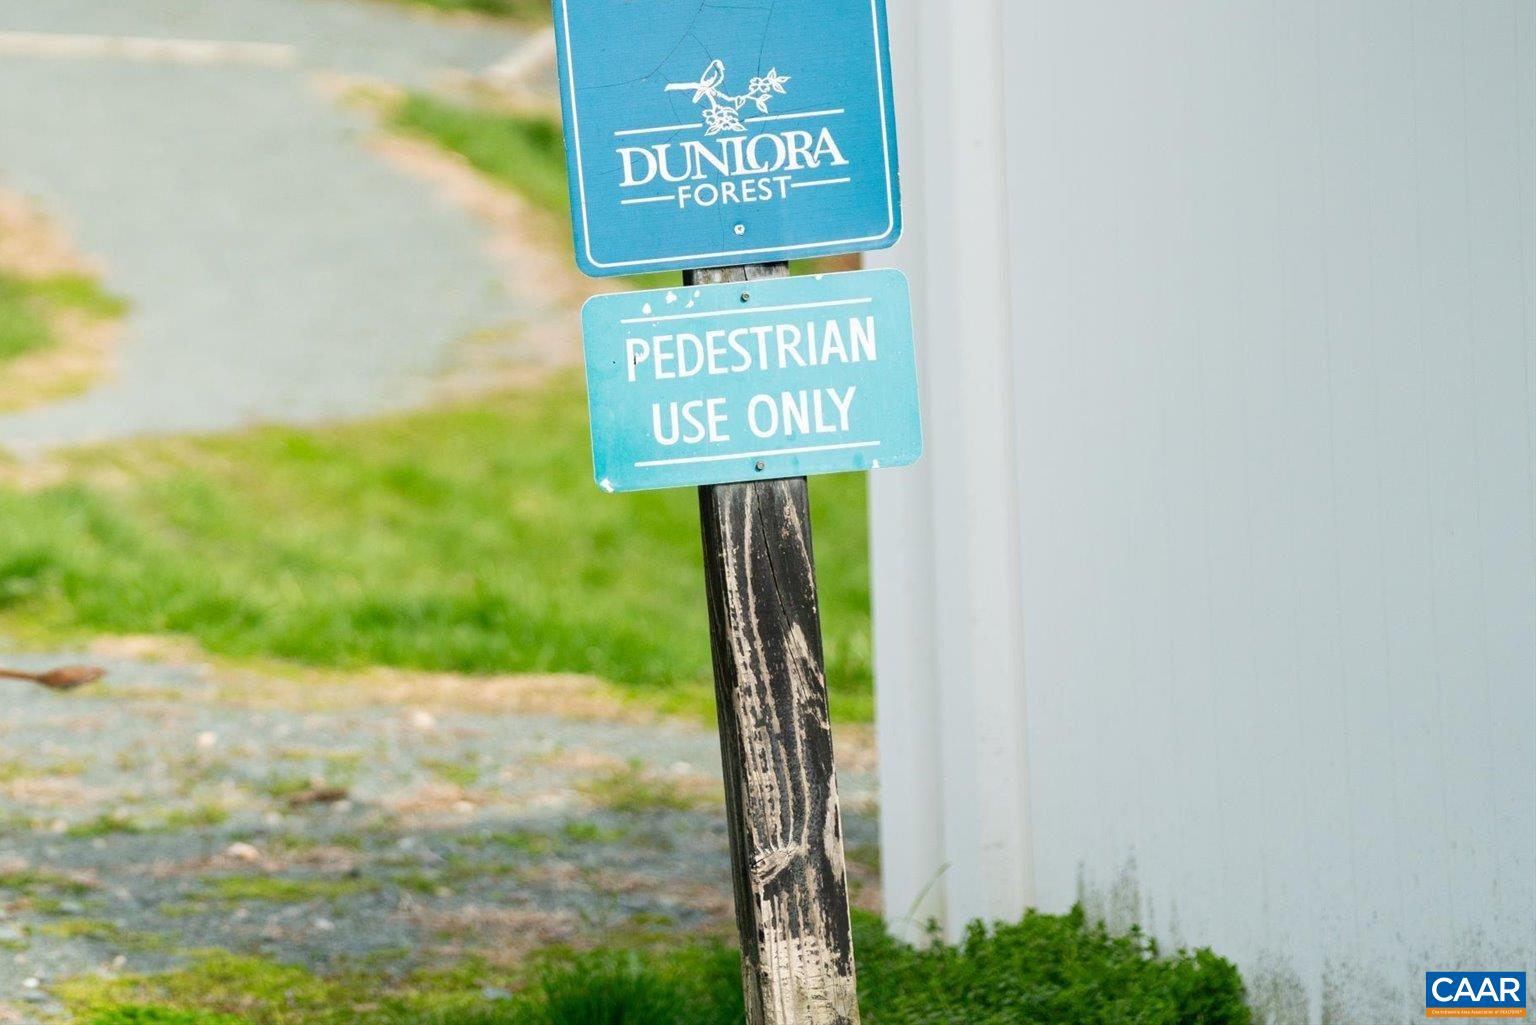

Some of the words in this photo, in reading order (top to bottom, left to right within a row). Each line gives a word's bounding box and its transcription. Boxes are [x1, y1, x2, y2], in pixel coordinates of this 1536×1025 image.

[615, 127, 849, 188] DUNLORA
[677, 175, 792, 209] FOREST
[625, 316, 877, 382] PEDESTRIAN
[652, 397, 730, 446] USE
[747, 386, 857, 440] ONLY
